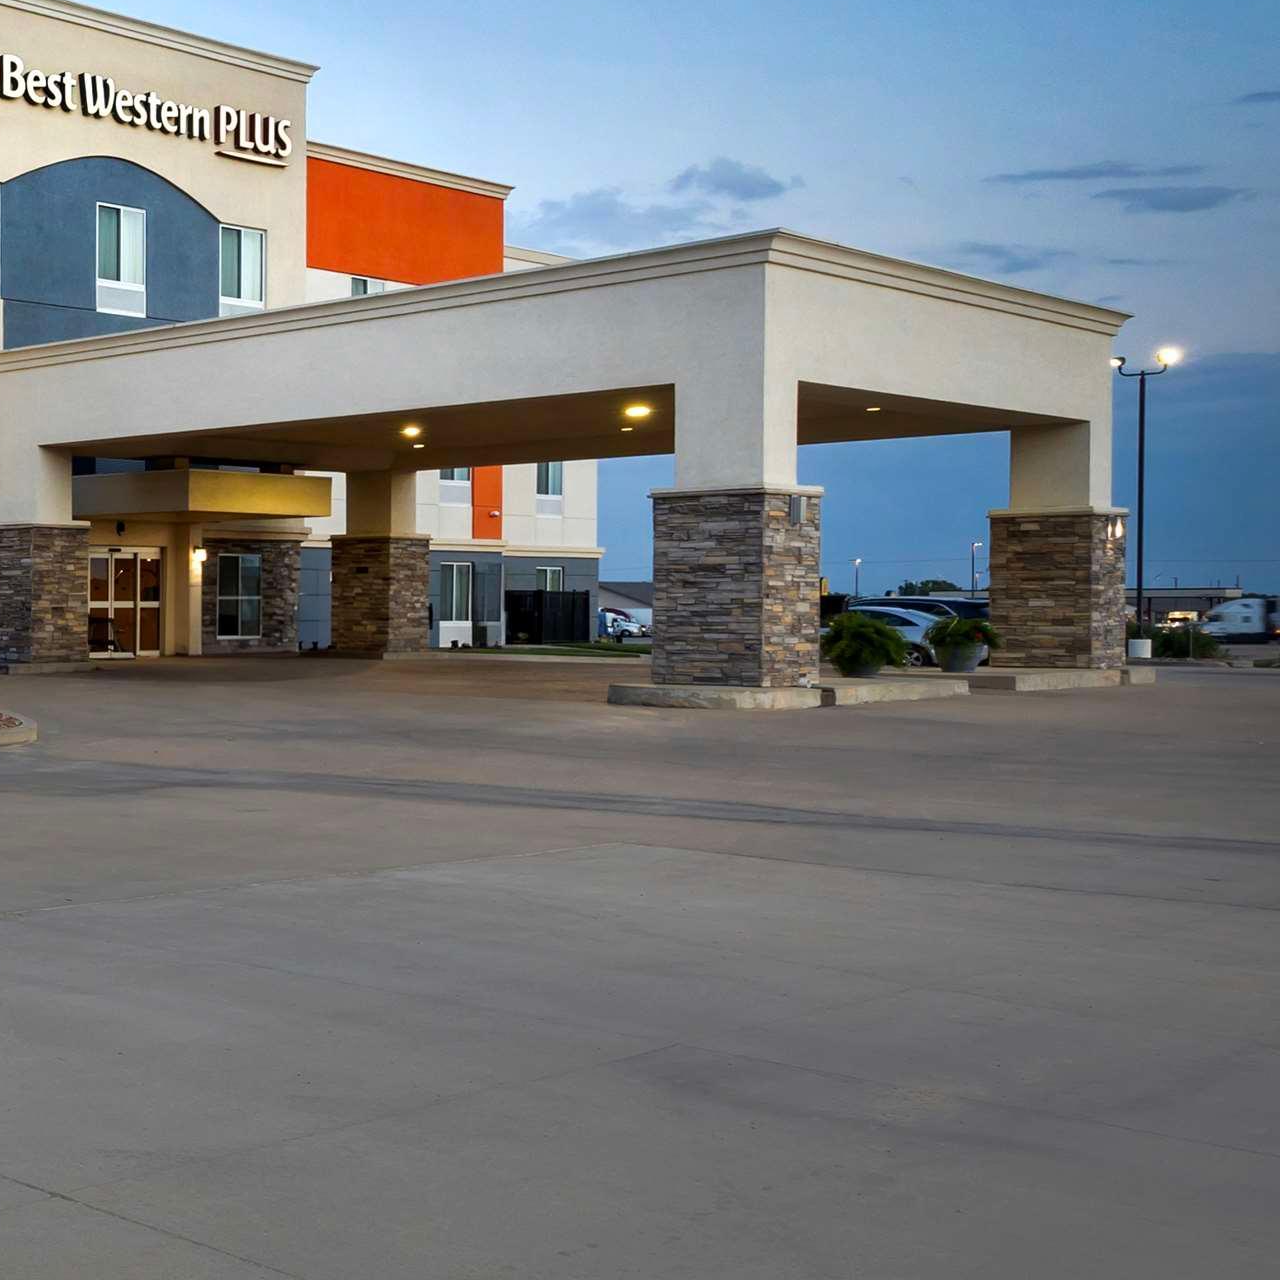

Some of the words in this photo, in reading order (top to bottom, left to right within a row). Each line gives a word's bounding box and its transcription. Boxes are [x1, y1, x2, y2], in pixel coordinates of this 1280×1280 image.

[1, 54, 77, 111] Best
[82, 72, 210, 140] Western
[218, 105, 292, 157] PLUS
